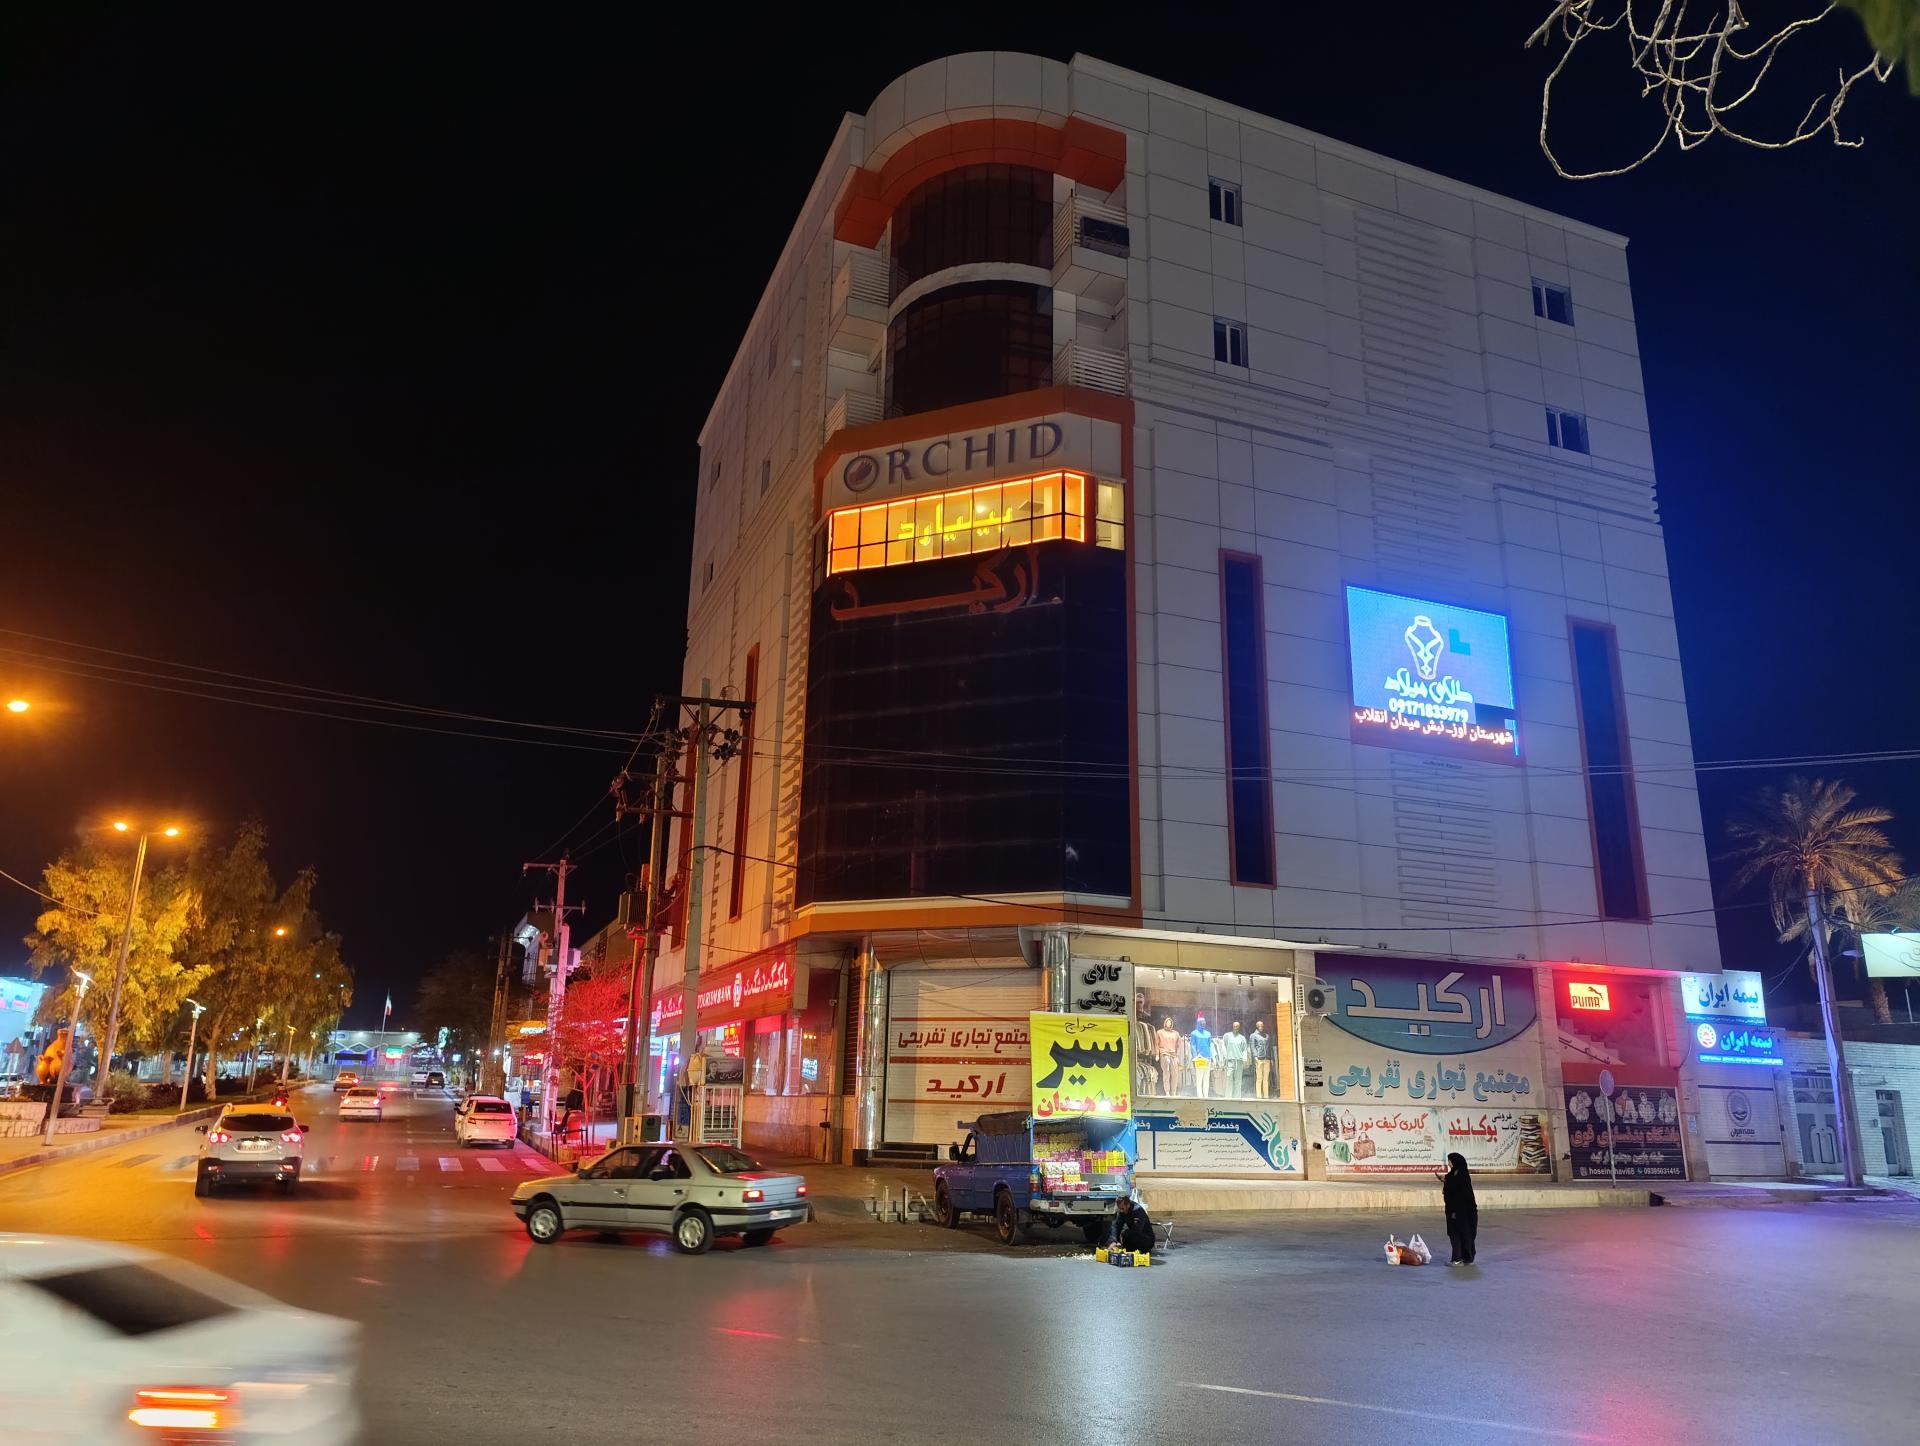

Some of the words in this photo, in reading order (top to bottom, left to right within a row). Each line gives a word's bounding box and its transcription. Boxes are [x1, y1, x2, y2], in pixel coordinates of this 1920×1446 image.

[843, 422, 1064, 492] ORCHID
[897, 499, 1014, 546] بیلیارد
[830, 538, 1040, 621] ارکید
[1354, 708, 1388, 725] انقلاب
[1390, 713, 1420, 730] میدان
[1082, 964, 1123, 985] کالای
[1078, 990, 1126, 1016] پزشکی
[1347, 972, 1505, 1039] ارکید
[1572, 996, 1600, 1008] PUMA
[1698, 981, 1730, 1009] ایران
[1732, 988, 1759, 1009] بیمه
[1065, 1017, 1098, 1033] حراج
[898, 1028, 946, 1049] تفریحی
[950, 1027, 993, 1048] تجاری
[993, 1029, 1032, 1053] جتمع
[1720, 1030, 1749, 1054] ایران
[1750, 1034, 1773, 1055] بیمه
[1036, 1034, 1125, 1088] سیر
[1328, 1061, 1402, 1098] تفریحی
[1407, 1061, 1467, 1101] تجاری
[1473, 1066, 1531, 1103] مجتمع
[1359, 1117, 1374, 1131] نور
[1376, 1112, 1401, 1132] کیف
[1502, 1121, 1518, 1130] کتاب
